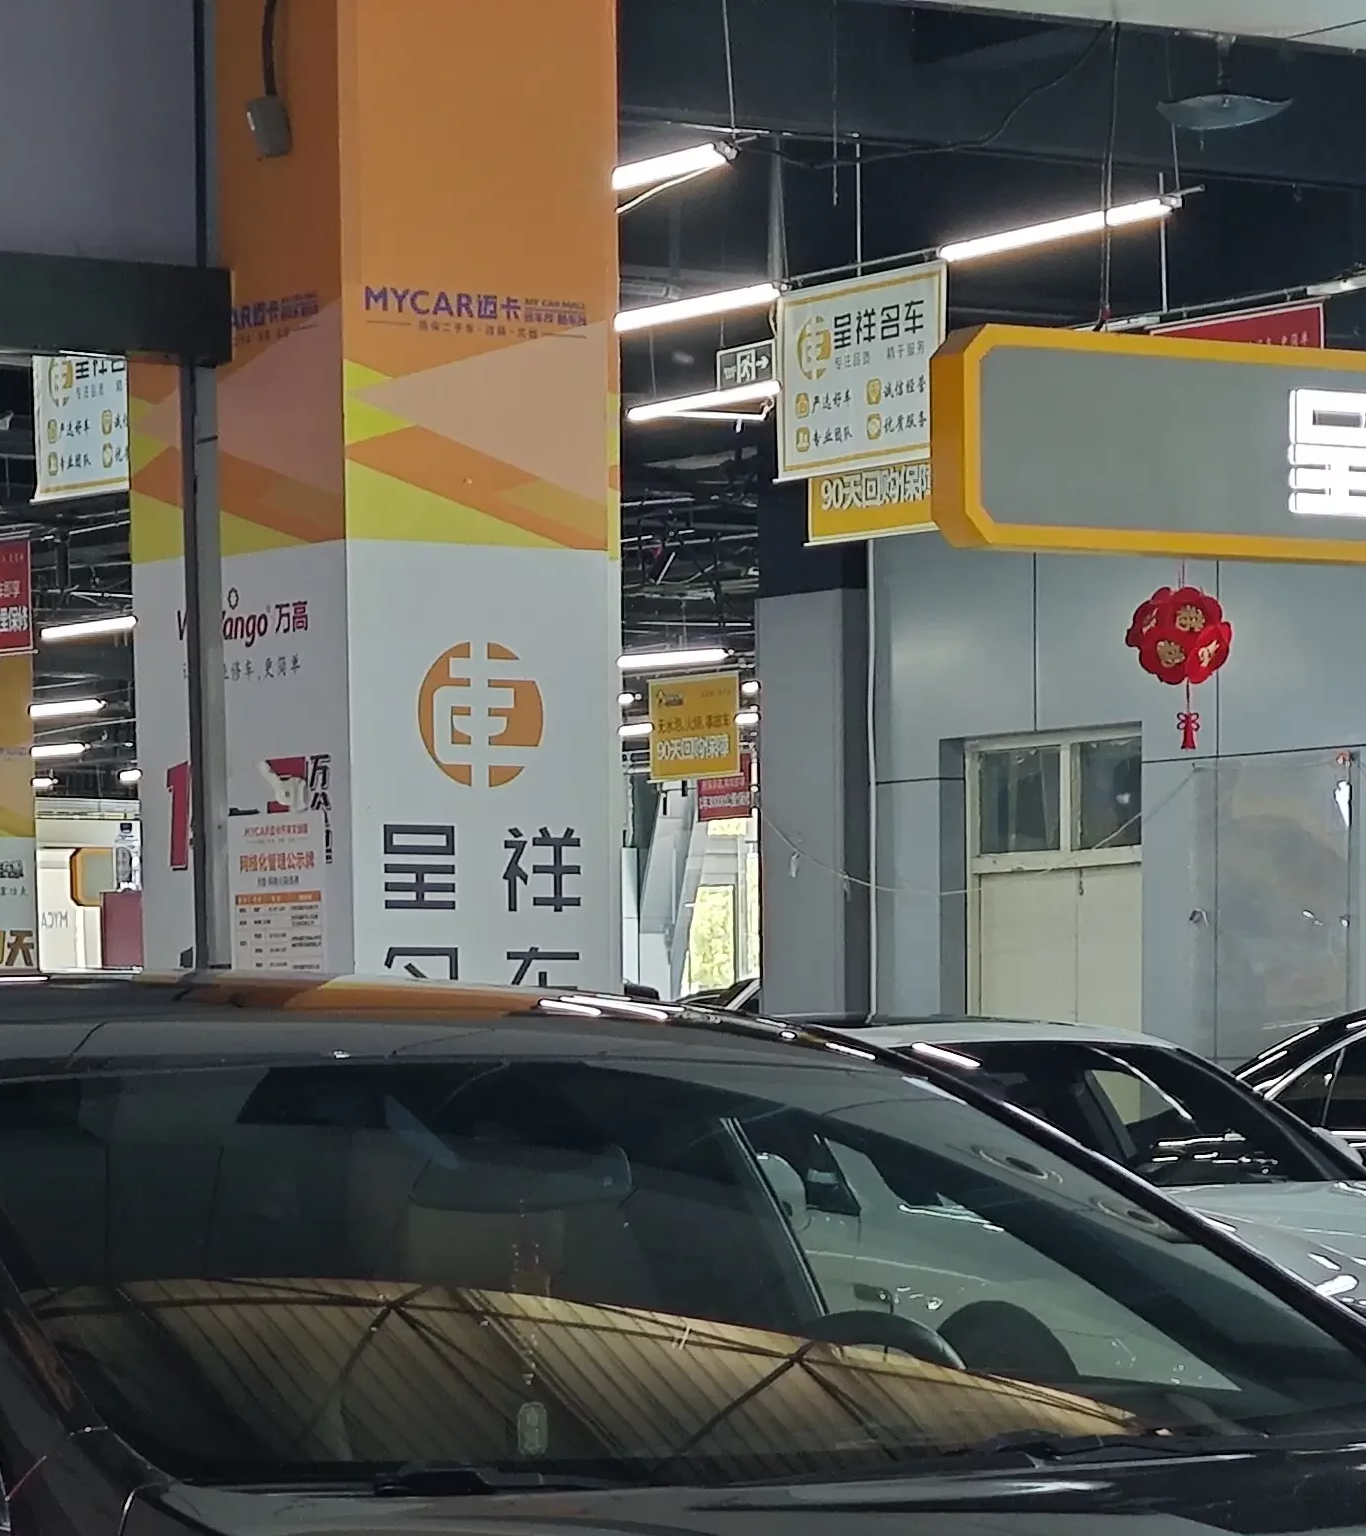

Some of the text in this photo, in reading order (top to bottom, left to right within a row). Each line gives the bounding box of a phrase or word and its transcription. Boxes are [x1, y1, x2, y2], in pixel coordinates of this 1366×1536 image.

[833, 299, 925, 350] 呈祥名车
[274, 600, 309, 634] 万高
[383, 823, 581, 912] 呈祥
